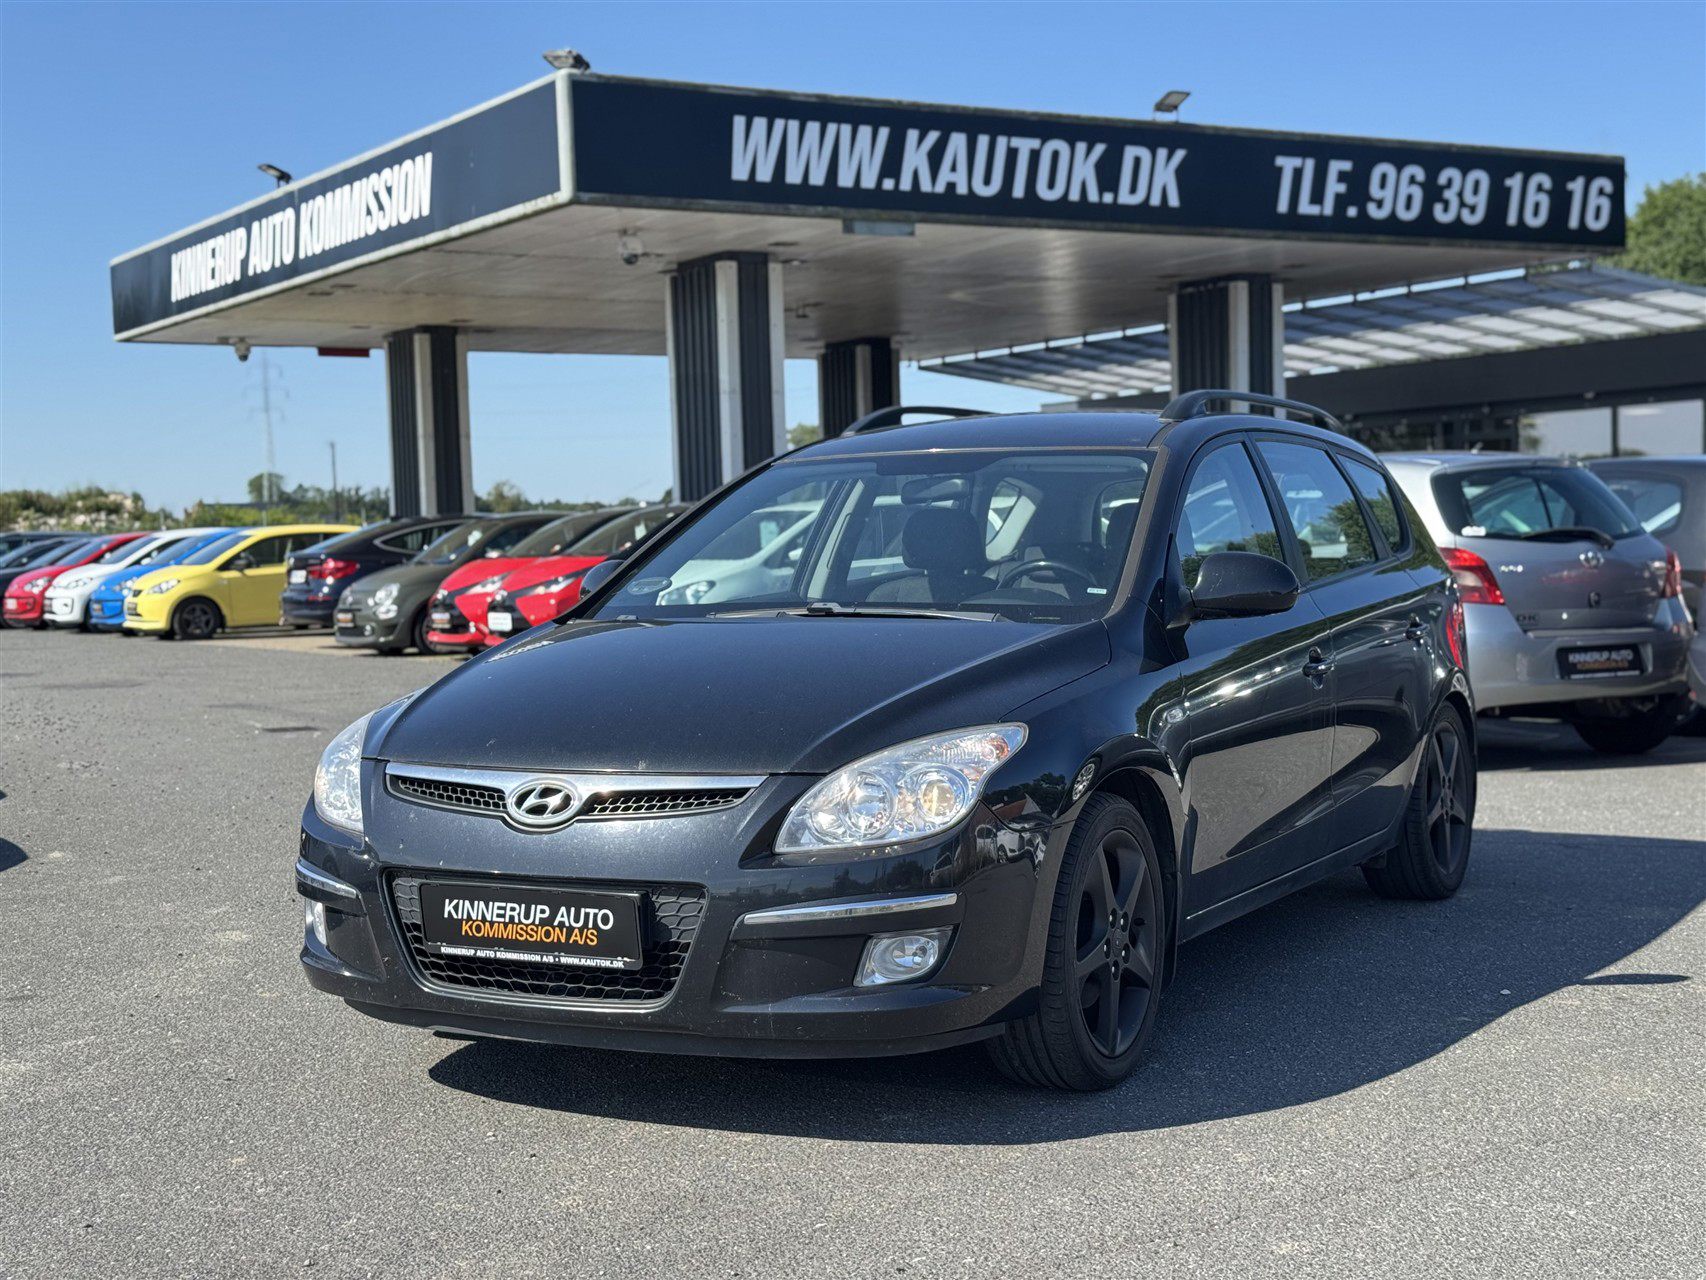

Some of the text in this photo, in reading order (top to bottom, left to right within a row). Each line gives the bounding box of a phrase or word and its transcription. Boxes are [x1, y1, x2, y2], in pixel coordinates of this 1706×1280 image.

[731, 114, 1187, 208] WWW.KAUTOK.DK
[1274, 155, 1614, 232] TLF. 96 39 16 16
[171, 152, 433, 302] KINNERUP AUTO KOMMISSION
[443, 899, 614, 930] KINNERUP AUTO
[461, 920, 598, 945] KOMMISSION A/S
[440, 946, 475, 956] KINNERUP
[476, 950, 495, 959] AUTO
[496, 951, 541, 962] KOMMISSION
[560, 956, 625, 968] WWW.KAUTOK.DK
